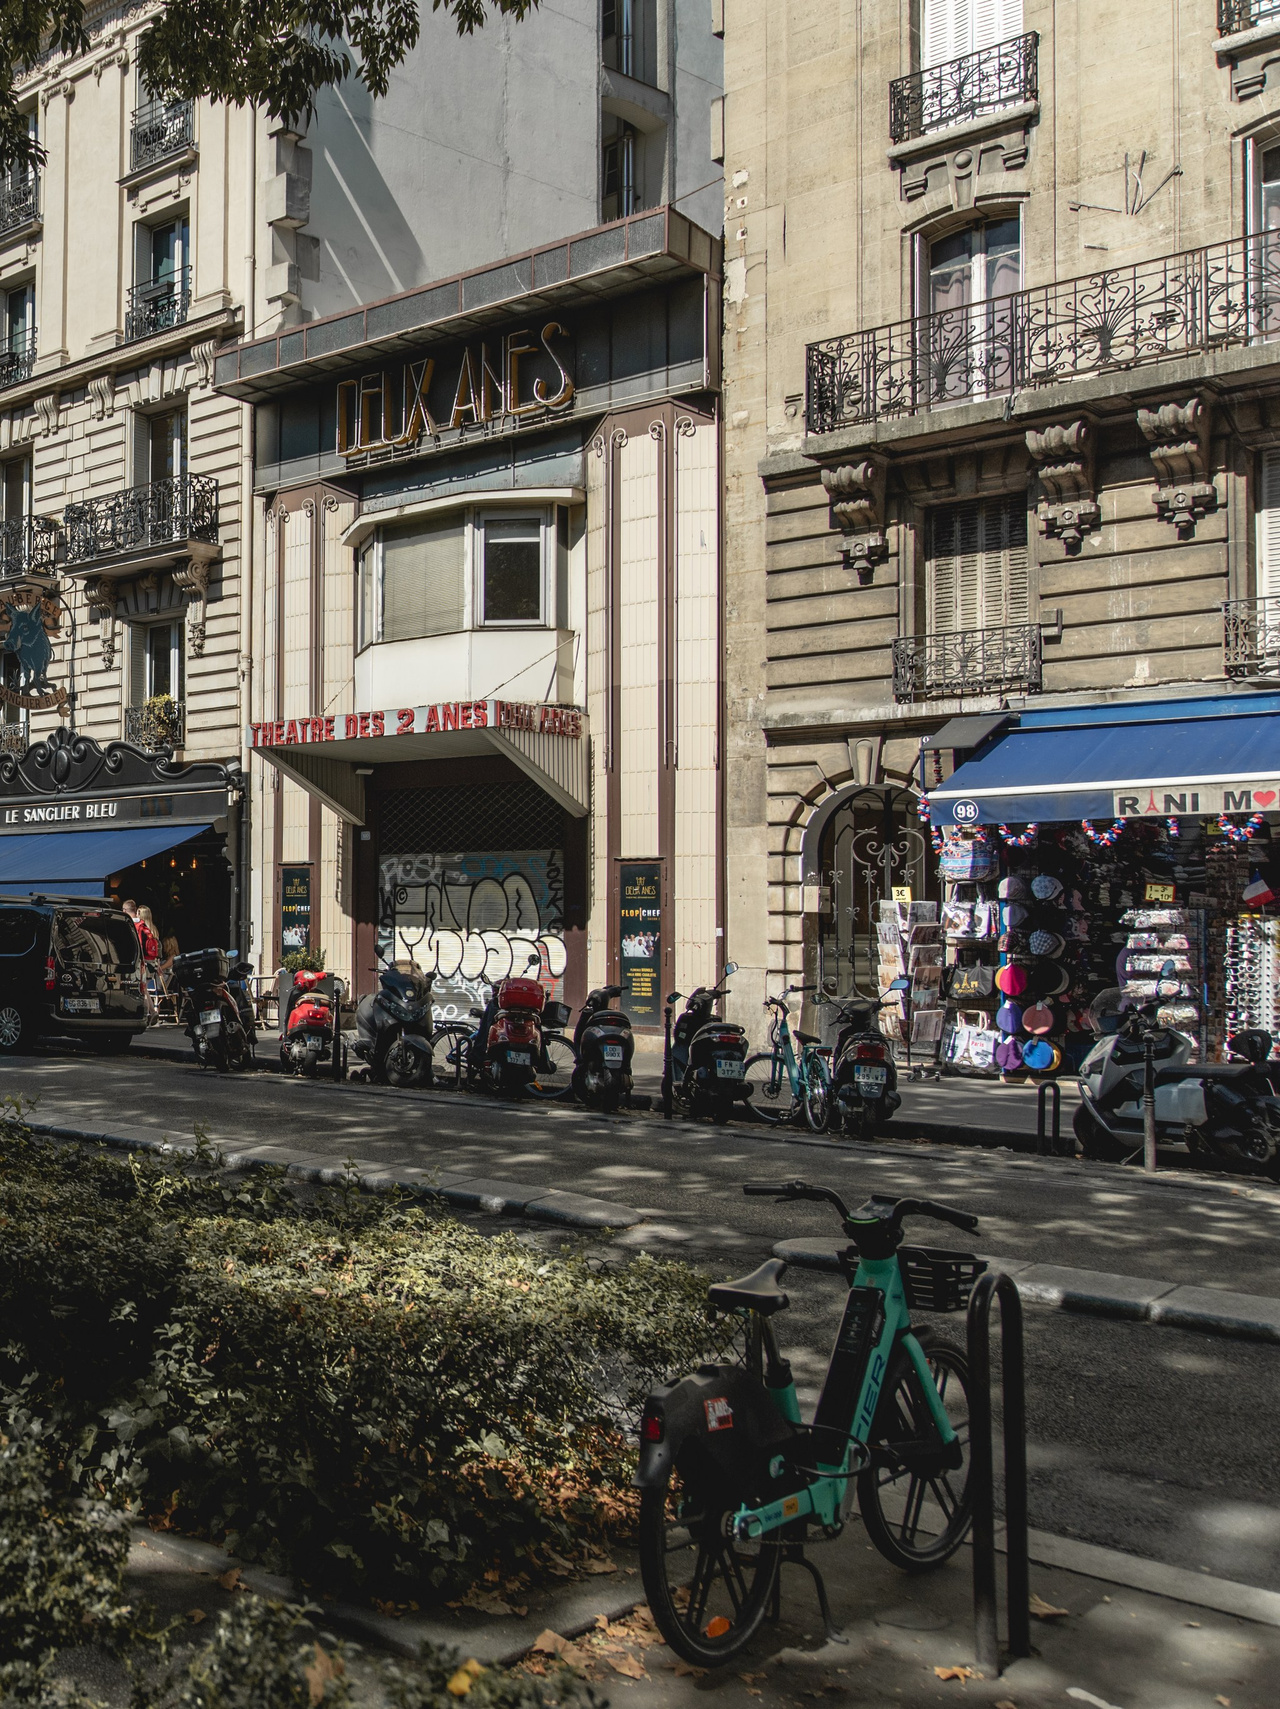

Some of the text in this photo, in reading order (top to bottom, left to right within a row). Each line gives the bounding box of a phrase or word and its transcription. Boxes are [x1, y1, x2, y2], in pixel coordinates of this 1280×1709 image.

[336, 321, 575, 457] DEUX ANES
[44, 689, 65, 707] BLEU
[249, 700, 488, 747] THEATRE DES 2 ANES
[5, 802, 118, 823] LE SANGLIER BLEU
[956, 804, 976, 819] 98
[895, 889, 906, 897] 3€
[621, 909, 661, 917] FLOP CHEF
[970, 1040, 985, 1048] Paris
